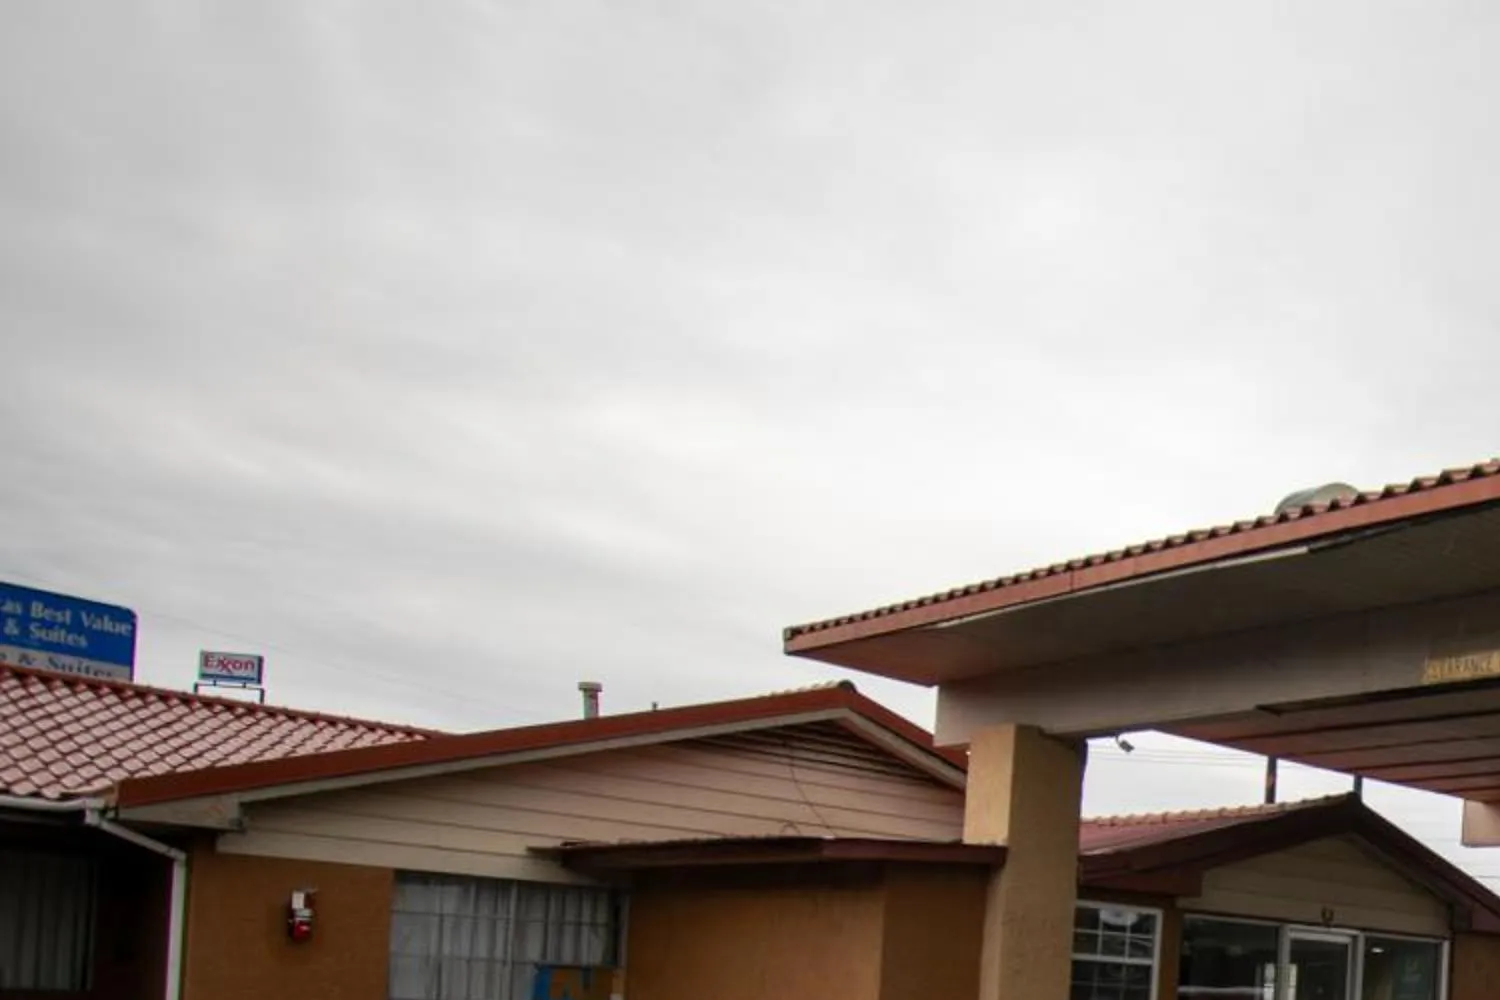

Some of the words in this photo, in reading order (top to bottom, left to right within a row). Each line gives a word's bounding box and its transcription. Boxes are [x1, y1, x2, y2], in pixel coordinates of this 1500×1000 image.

[0, 598, 22, 615] as
[30, 600, 72, 625] Best
[80, 610, 132, 637] Value
[3, 617, 20, 635] &
[29, 621, 88, 647] Suites
[203, 653, 255, 674] Exxon
